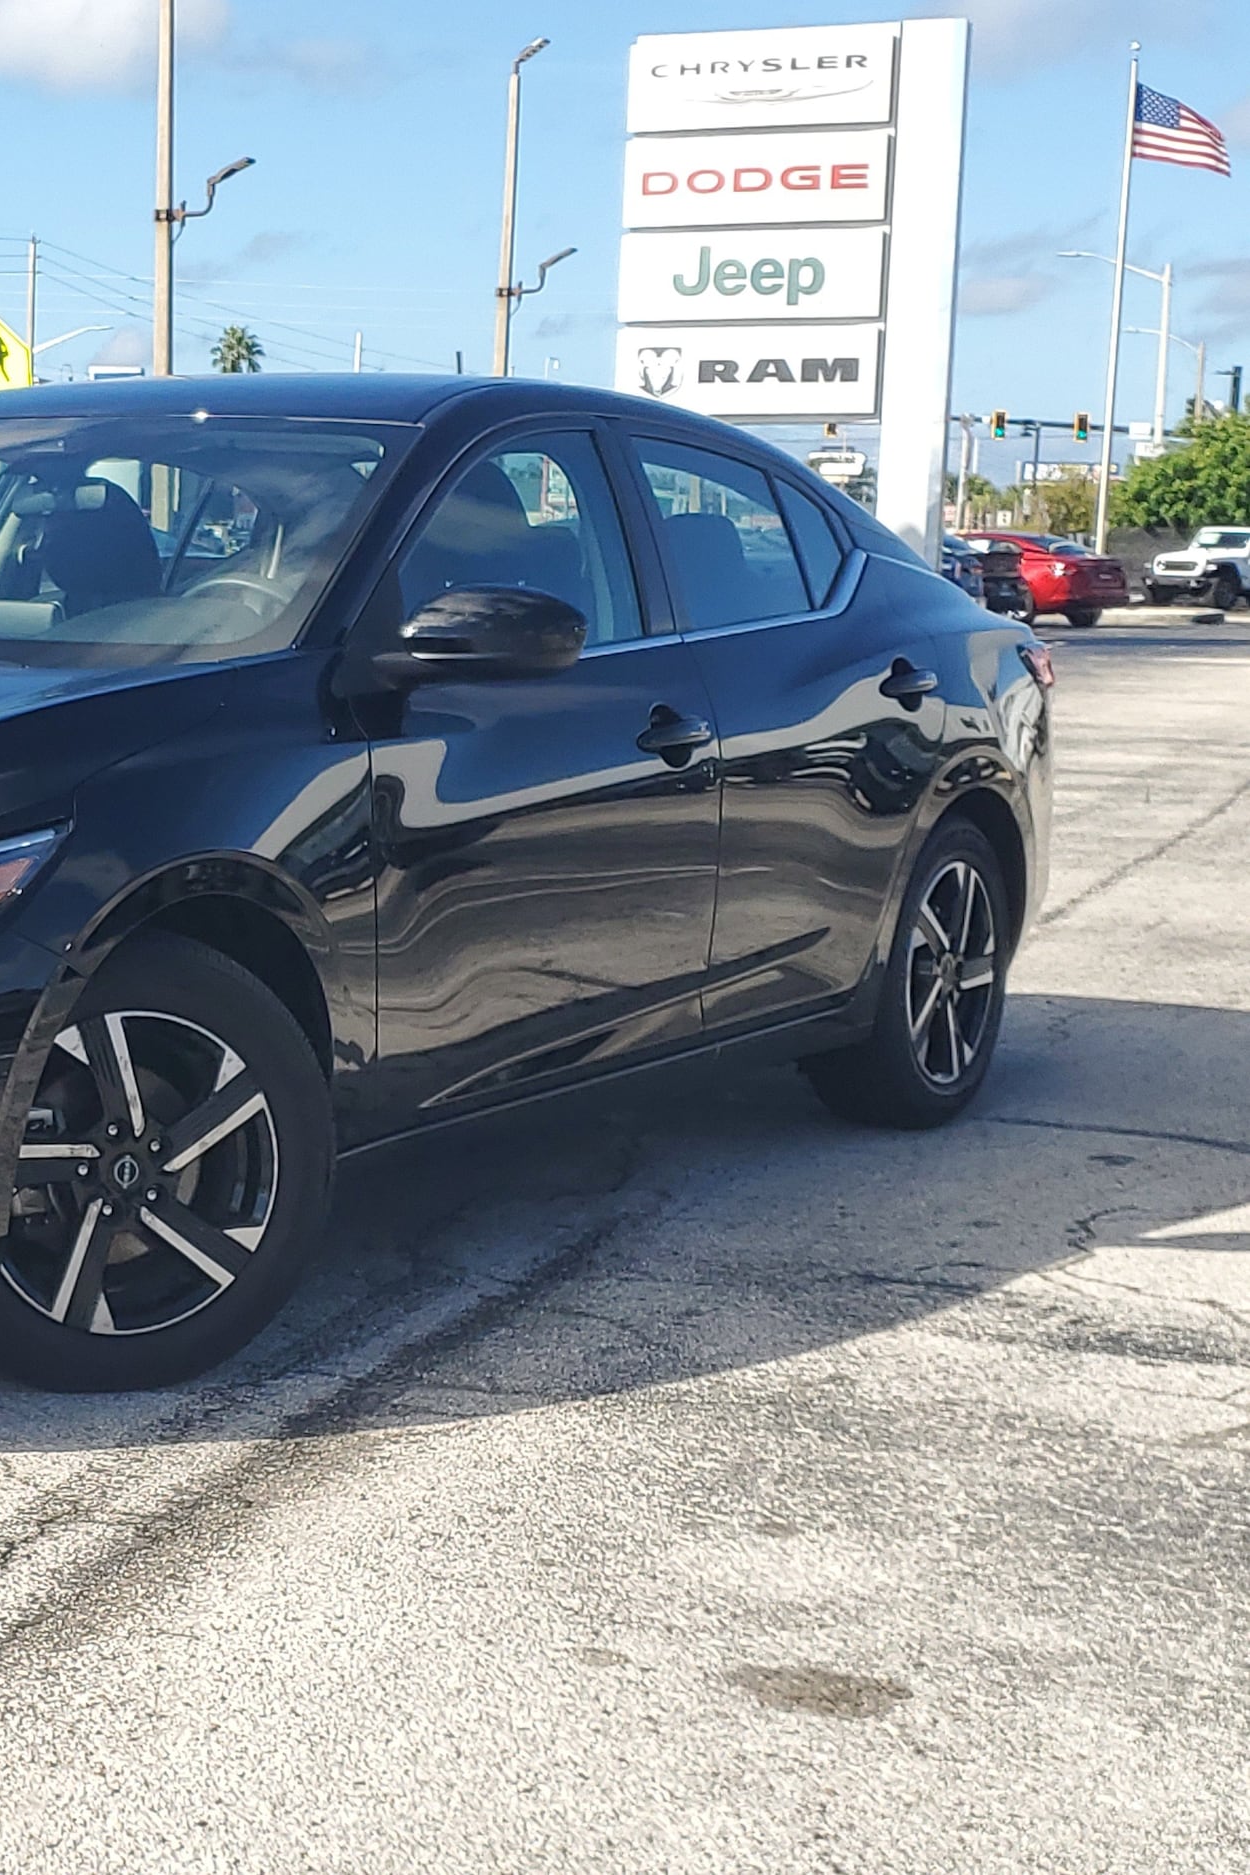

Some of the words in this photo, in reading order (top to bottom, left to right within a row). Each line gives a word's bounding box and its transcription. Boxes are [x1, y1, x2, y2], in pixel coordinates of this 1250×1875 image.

[651, 54, 867, 78] CHRYSLER
[642, 164, 869, 196] DODGE
[673, 246, 825, 306] Jeep
[698, 358, 859, 383] RAM
